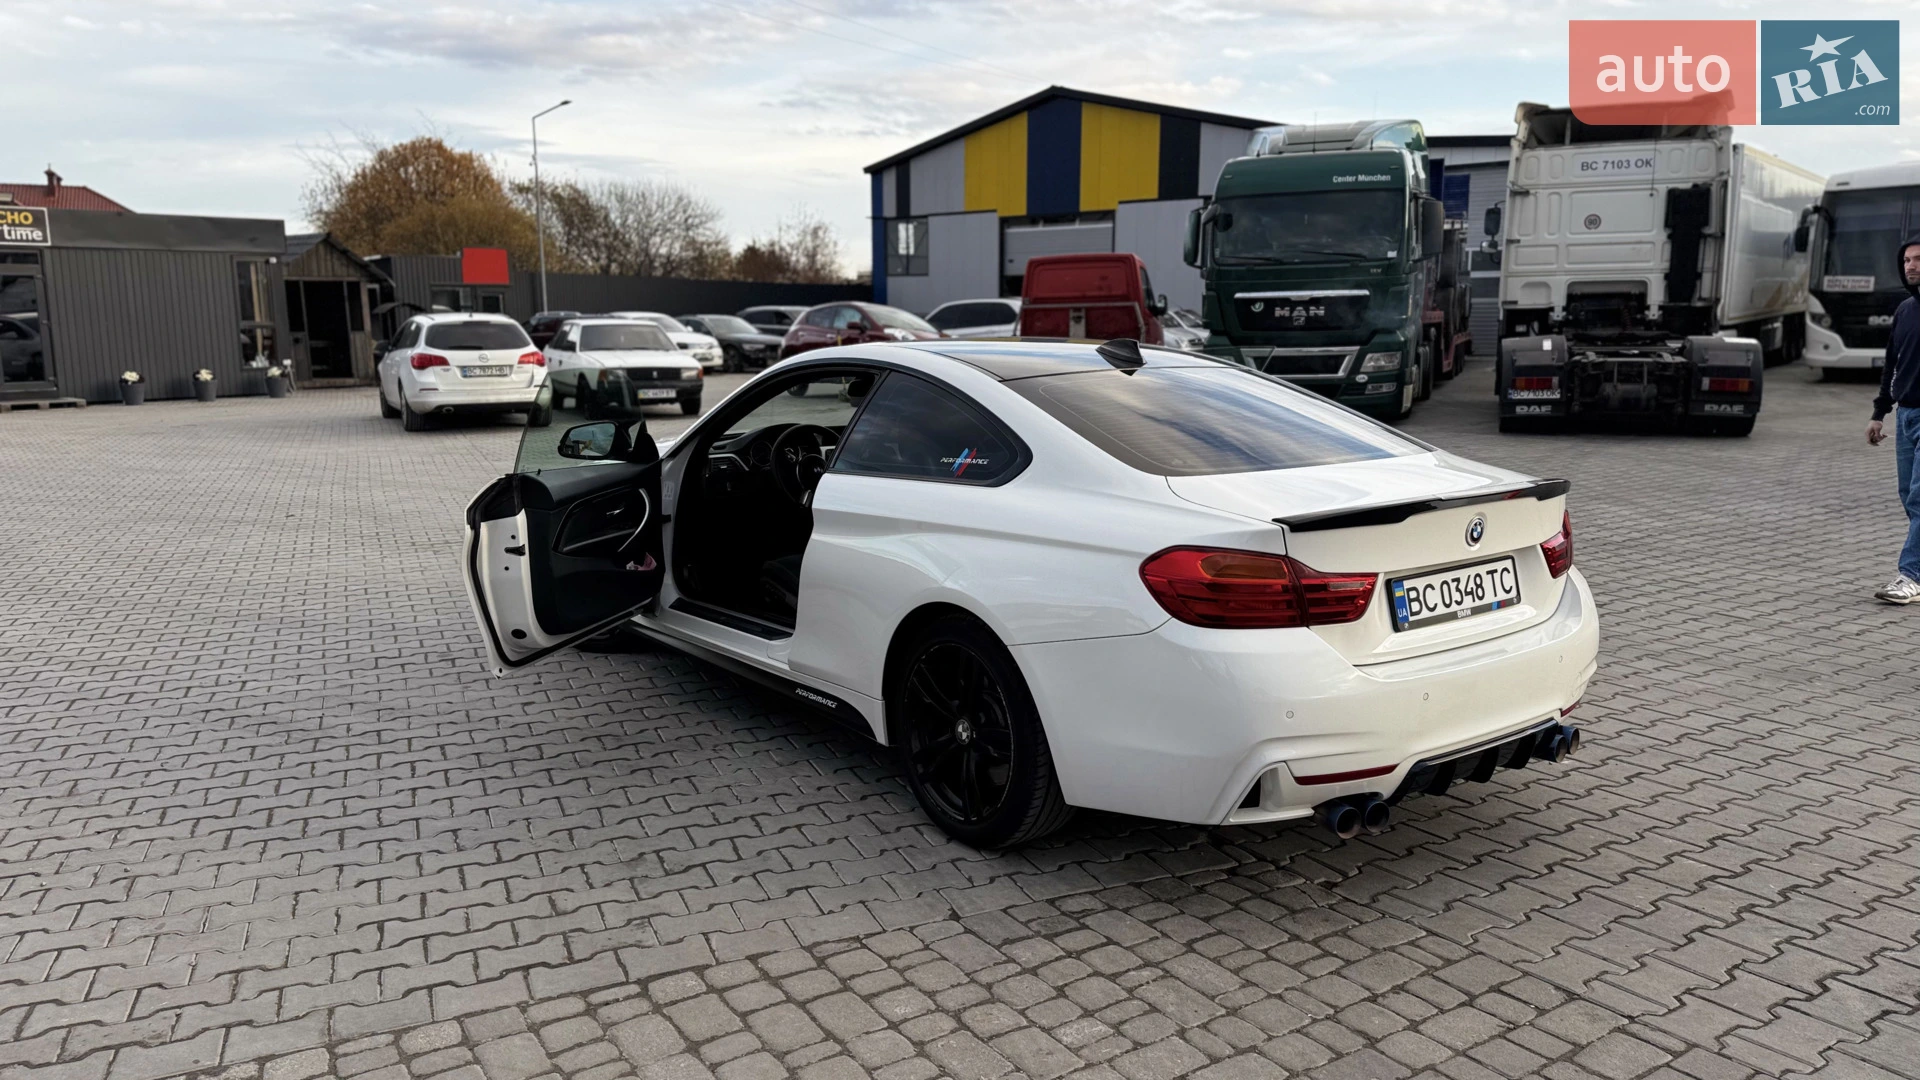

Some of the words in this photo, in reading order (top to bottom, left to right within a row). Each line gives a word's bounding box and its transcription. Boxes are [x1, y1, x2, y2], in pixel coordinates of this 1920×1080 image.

[1581, 161, 1599, 171] BC
[1602, 159, 1631, 170] 7103
[1634, 158, 1653, 169] OK
[1274, 306, 1326, 317] MAN
[1516, 405, 1552, 414] DAF
[1704, 404, 1744, 414] DAF
[1406, 584, 1437, 616] BC
[1440, 573, 1485, 608] 0348
[1486, 567, 1512, 597] TC
[1397, 608, 1408, 618] UA
[1457, 609, 1472, 619] BMW
[795, 687, 838, 709] PERFORMANCE
